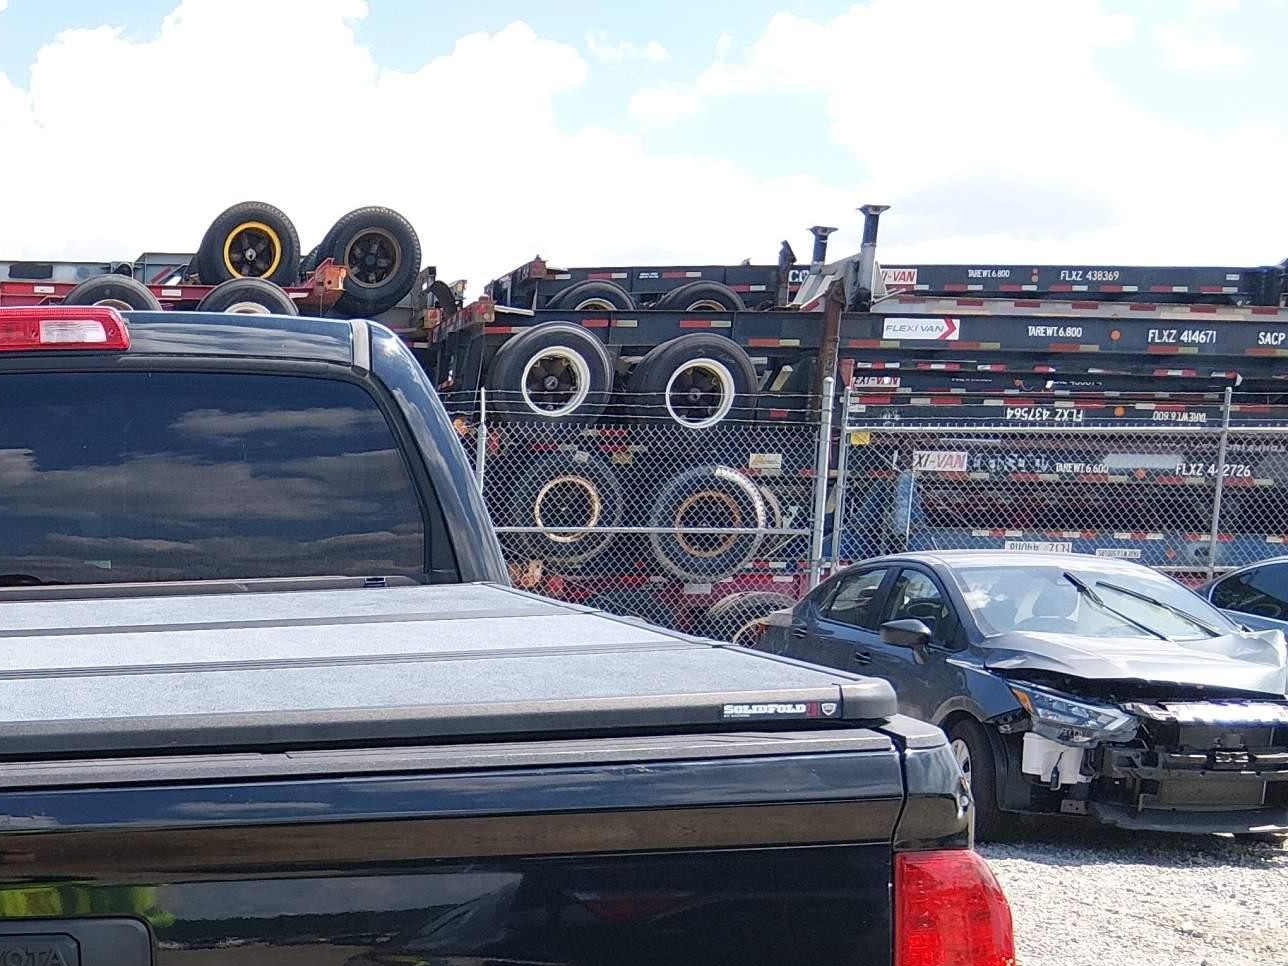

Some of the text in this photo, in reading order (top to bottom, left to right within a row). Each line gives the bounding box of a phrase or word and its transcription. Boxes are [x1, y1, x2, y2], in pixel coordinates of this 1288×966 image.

[1060, 270, 1119, 282] FLXZ 438369
[885, 324, 945, 334] FLEXI VAN
[1148, 330, 1216, 344] FLXZ 414671
[1258, 332, 1286, 345] SACP
[1006, 408, 1083, 422] FLXZ 437564
[1176, 464, 1251, 477] FLXZ 42726
